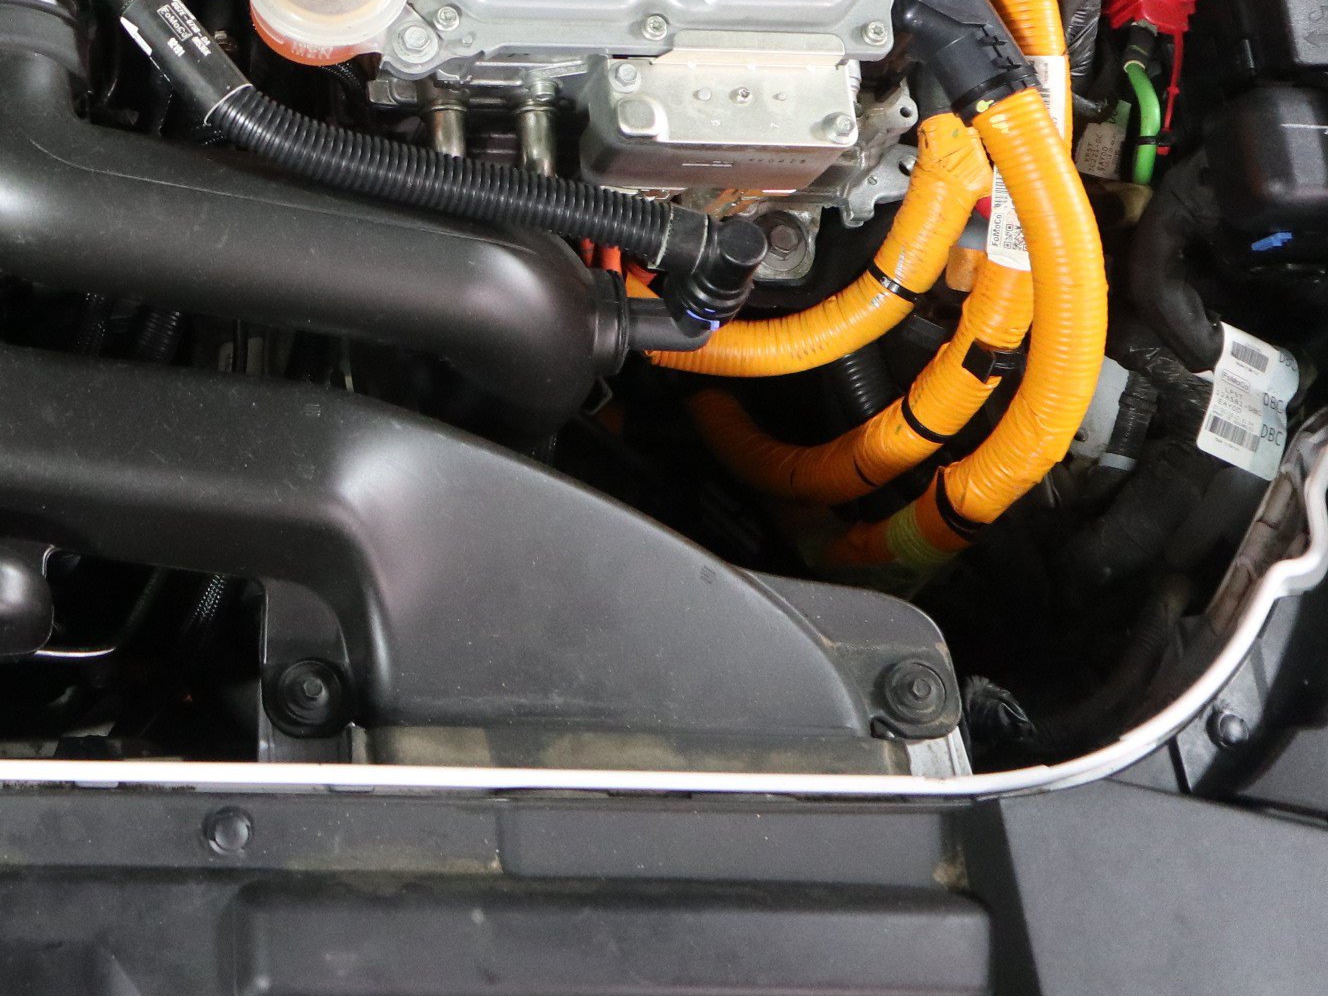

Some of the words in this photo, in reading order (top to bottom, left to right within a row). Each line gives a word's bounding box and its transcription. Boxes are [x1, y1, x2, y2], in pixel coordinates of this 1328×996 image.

[991, 214, 1002, 246] FoMoCo
[1262, 392, 1285, 414] DBC
[1260, 423, 1283, 446] DBC
